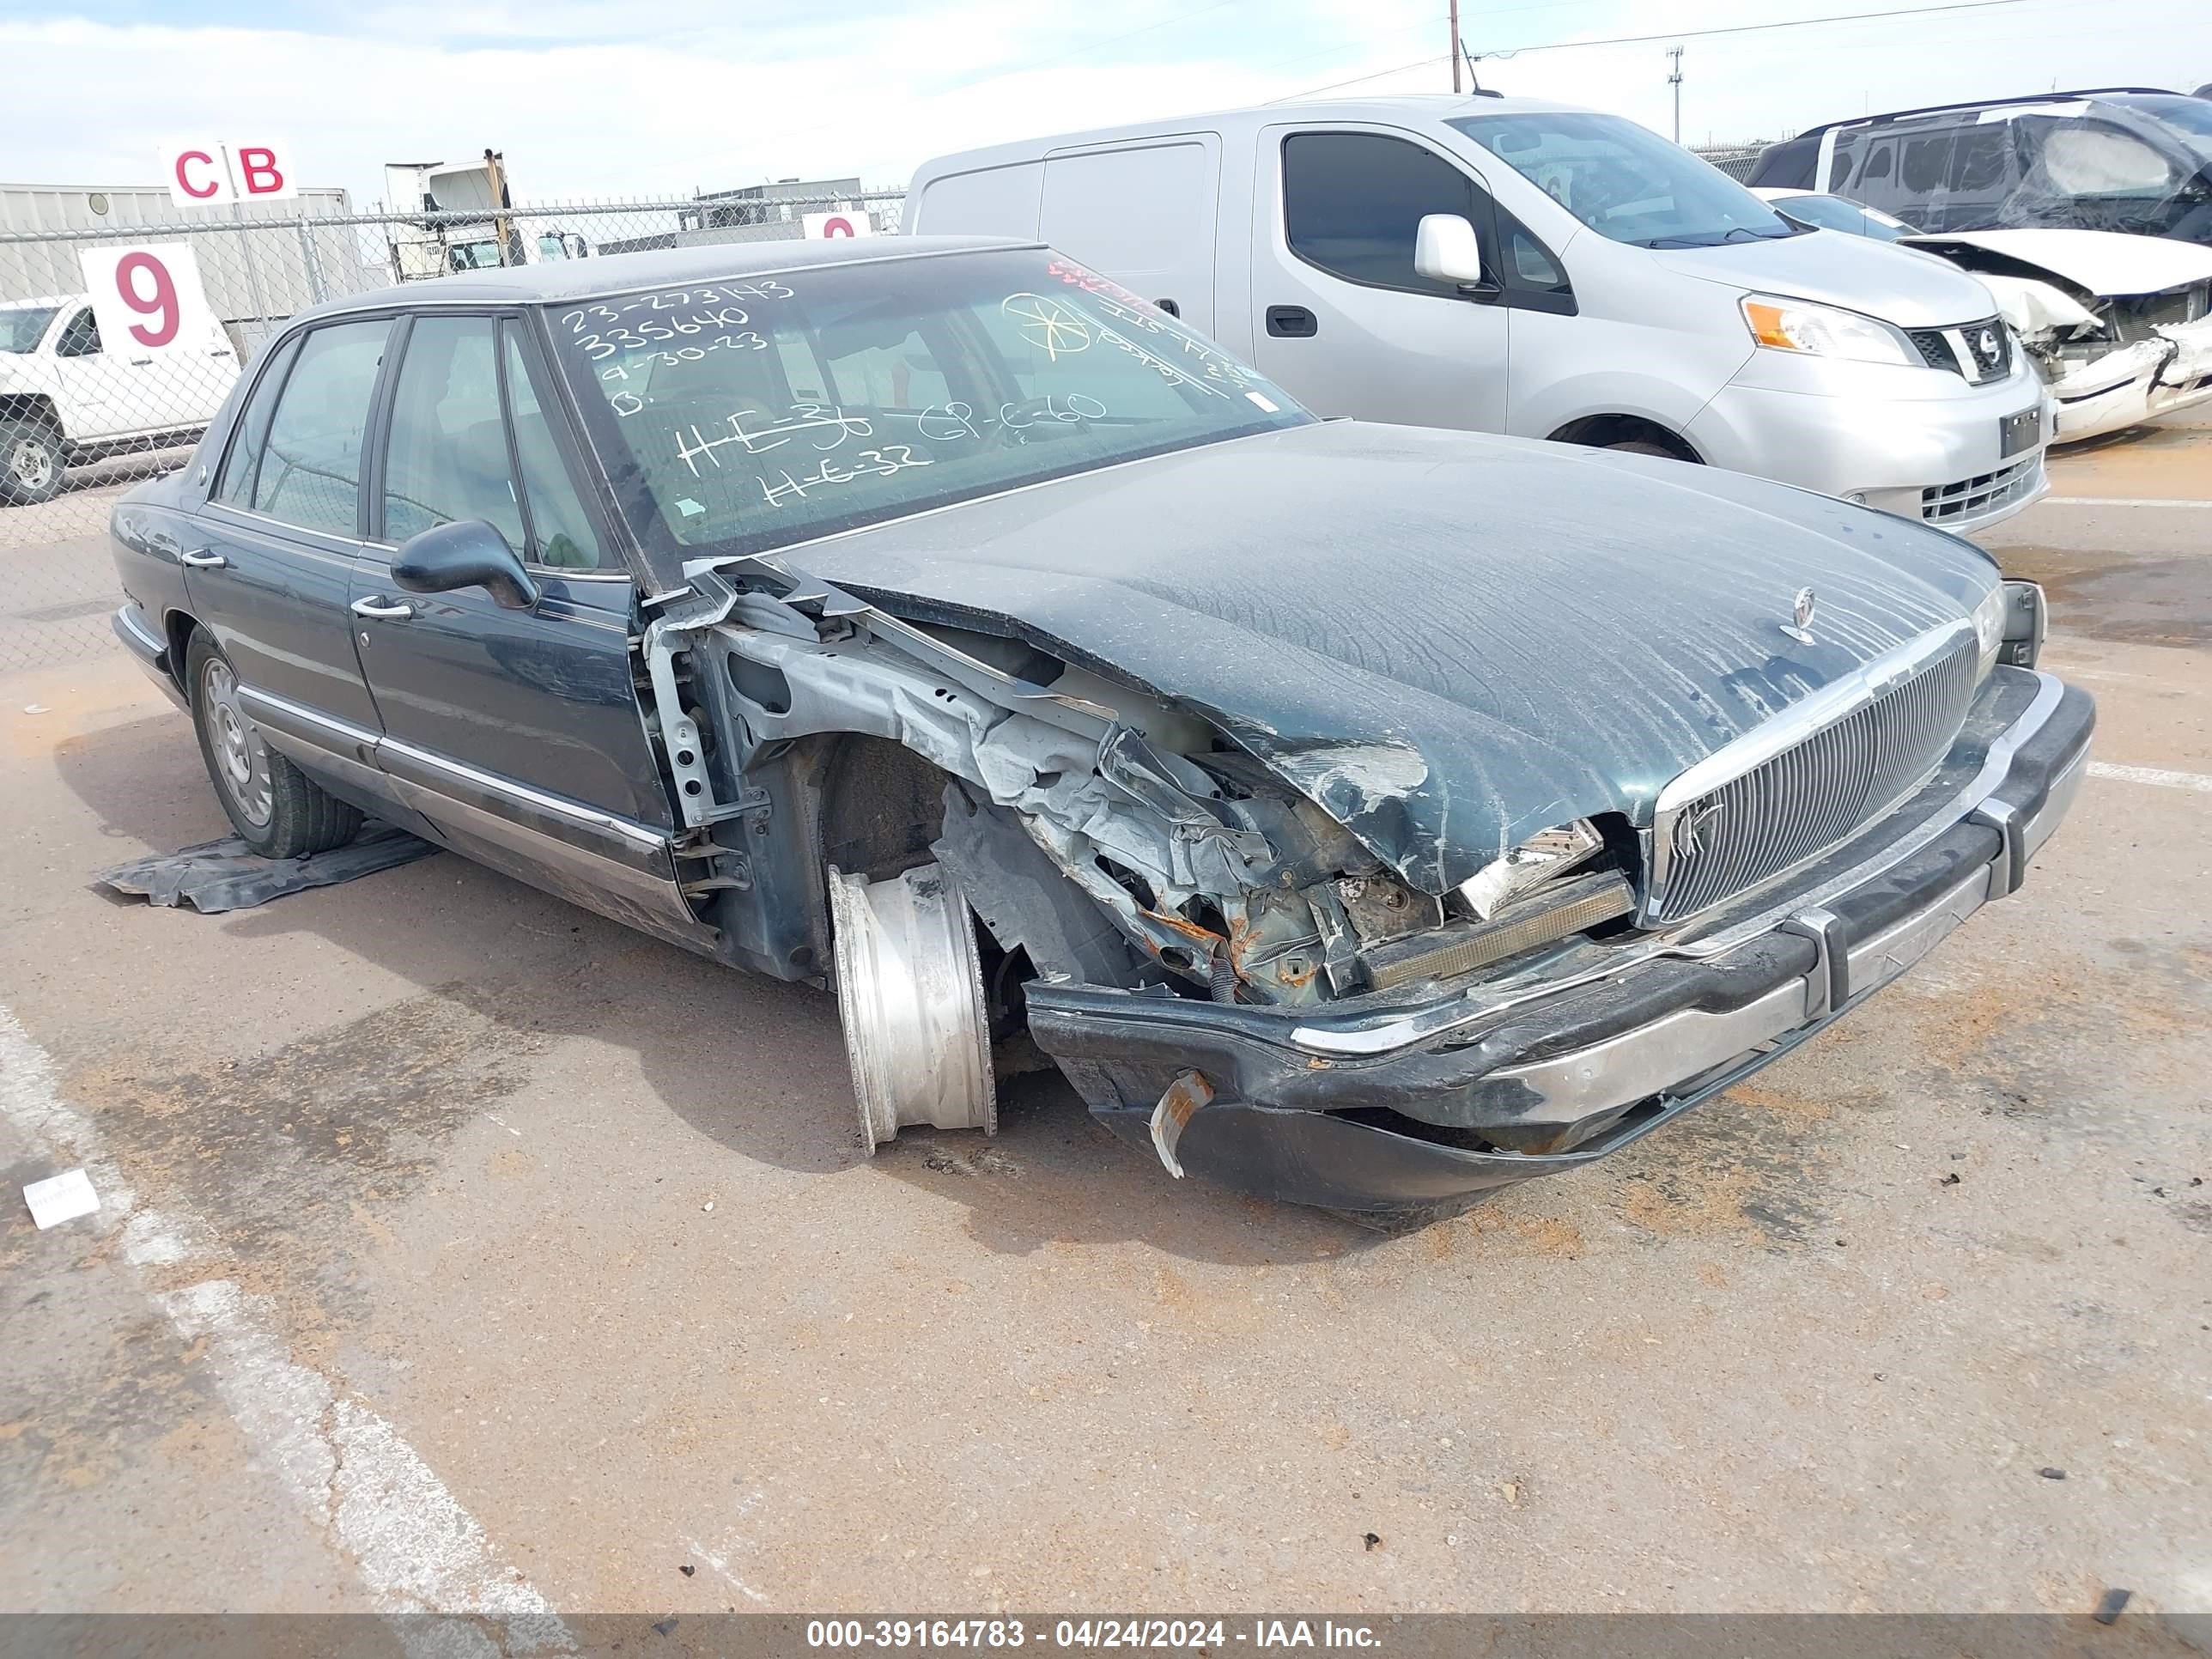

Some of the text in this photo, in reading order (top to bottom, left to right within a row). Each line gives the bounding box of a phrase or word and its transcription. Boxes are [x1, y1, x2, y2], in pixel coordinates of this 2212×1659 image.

[175, 150, 219, 198] C
[239, 147, 284, 194] B
[115, 251, 180, 348] 9
[562, 280, 795, 335] 23-273143
[574, 306, 750, 361] 335640
